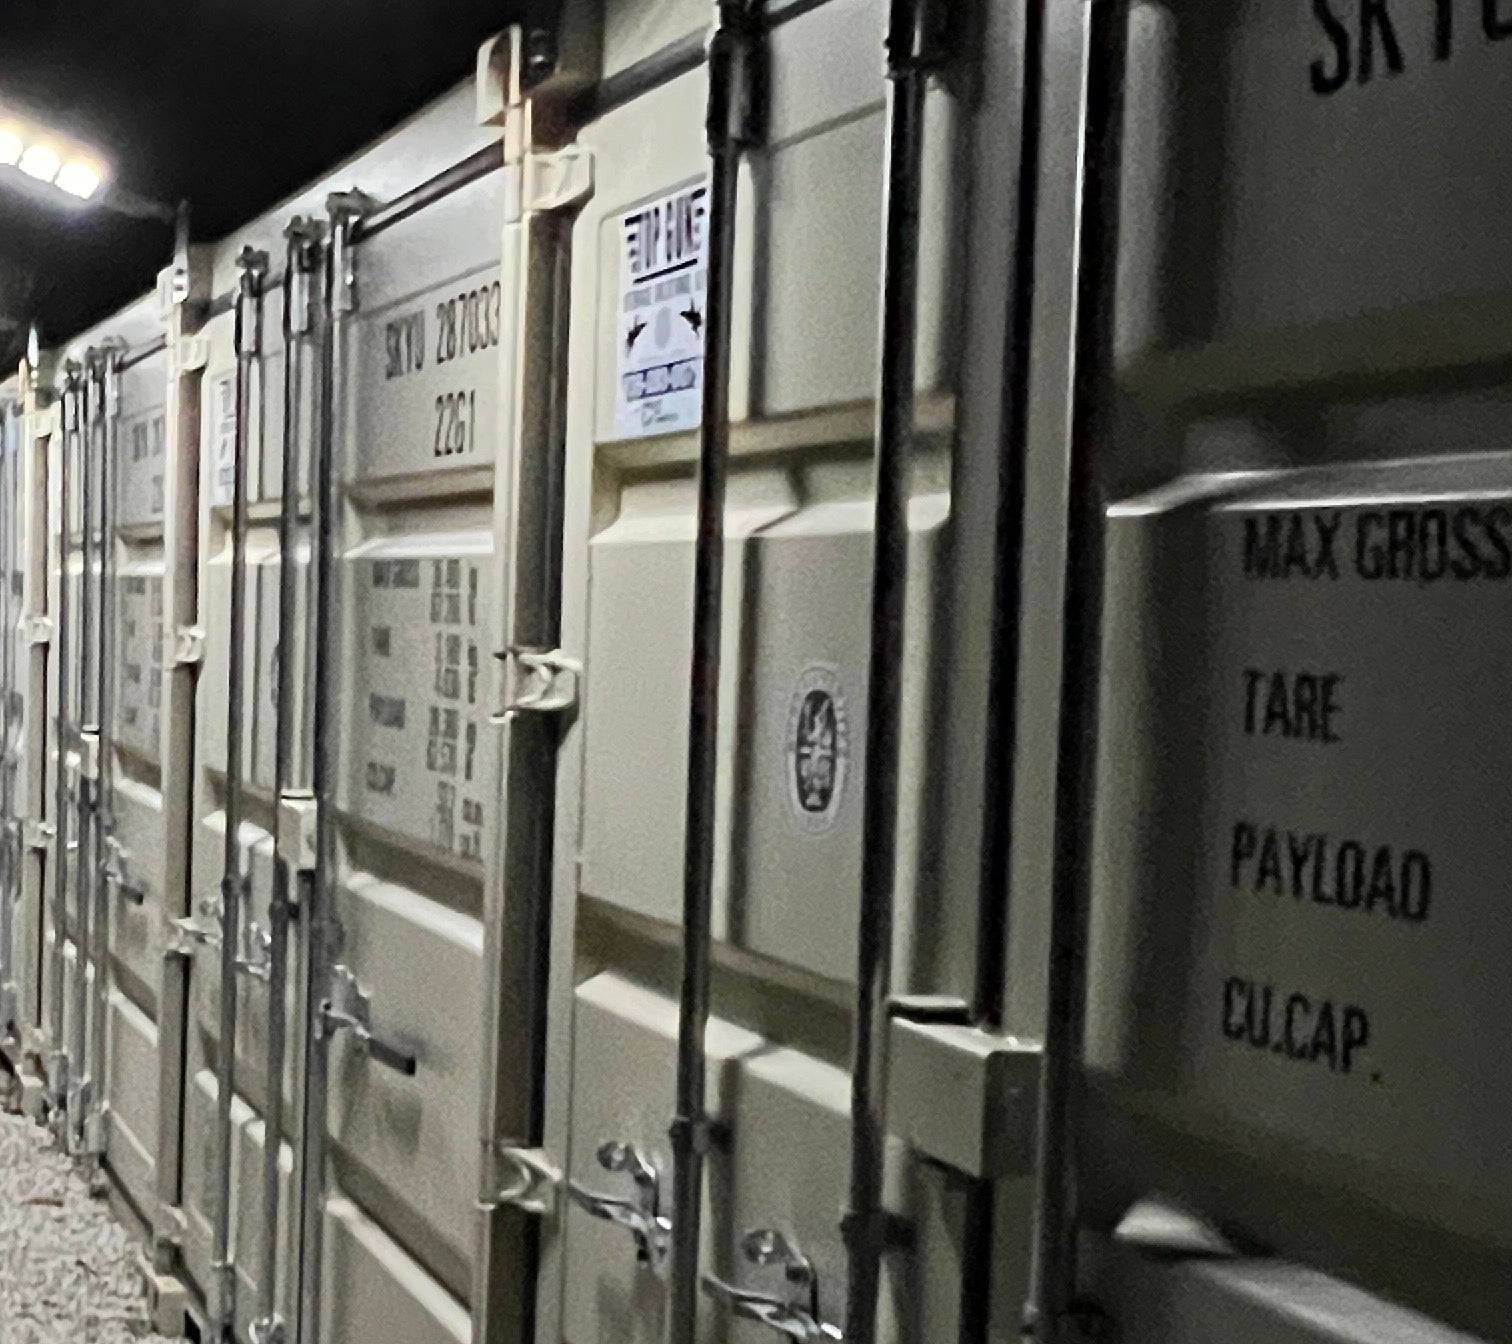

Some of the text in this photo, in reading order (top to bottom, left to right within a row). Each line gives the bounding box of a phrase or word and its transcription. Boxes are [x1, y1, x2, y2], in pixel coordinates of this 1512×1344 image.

[1242, 507, 1512, 582] MAX GROSS
[1242, 669, 1342, 744] TARE
[1231, 821, 1431, 923] PAYLOAD
